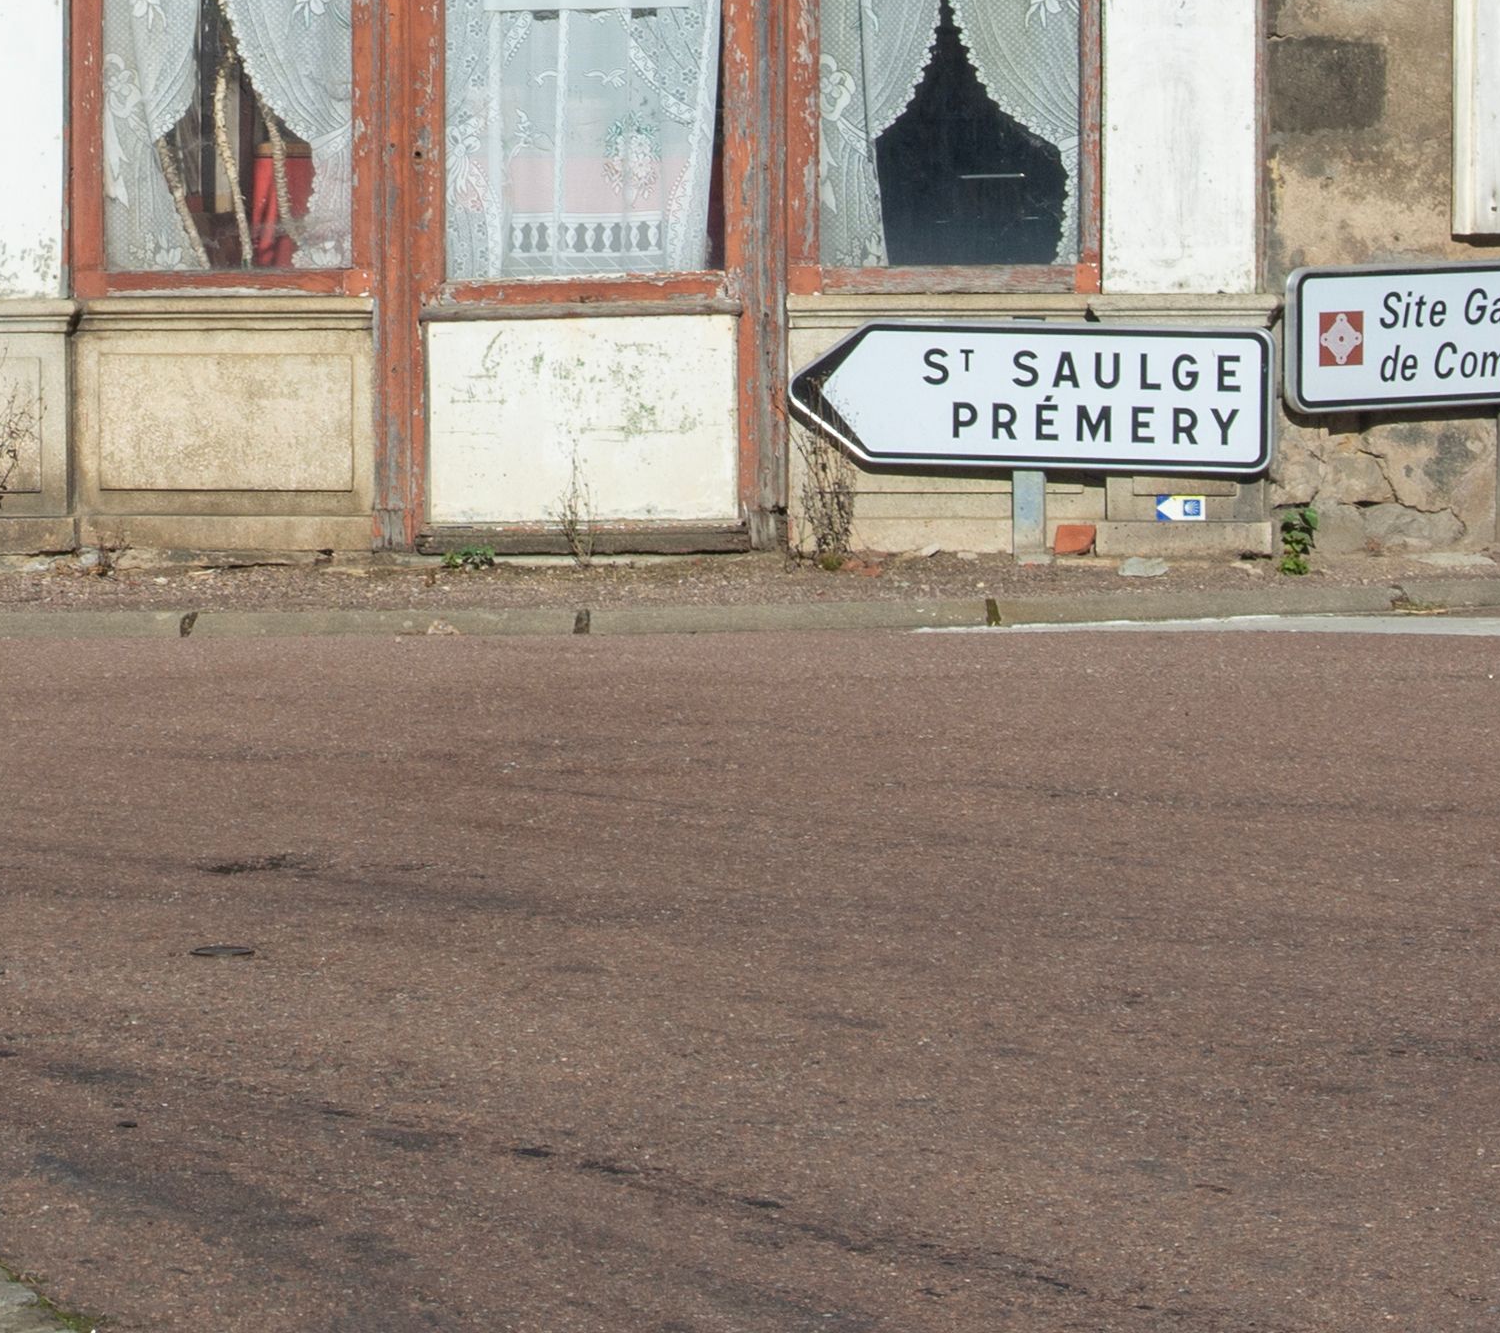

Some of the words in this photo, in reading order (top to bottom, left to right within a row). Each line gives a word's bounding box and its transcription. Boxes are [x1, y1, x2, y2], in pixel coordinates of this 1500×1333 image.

[1379, 291, 1447, 329] Site
[1013, 350, 1242, 392] SAULGE
[1380, 344, 1419, 382] de
[952, 394, 1240, 446] PRÉMERY
